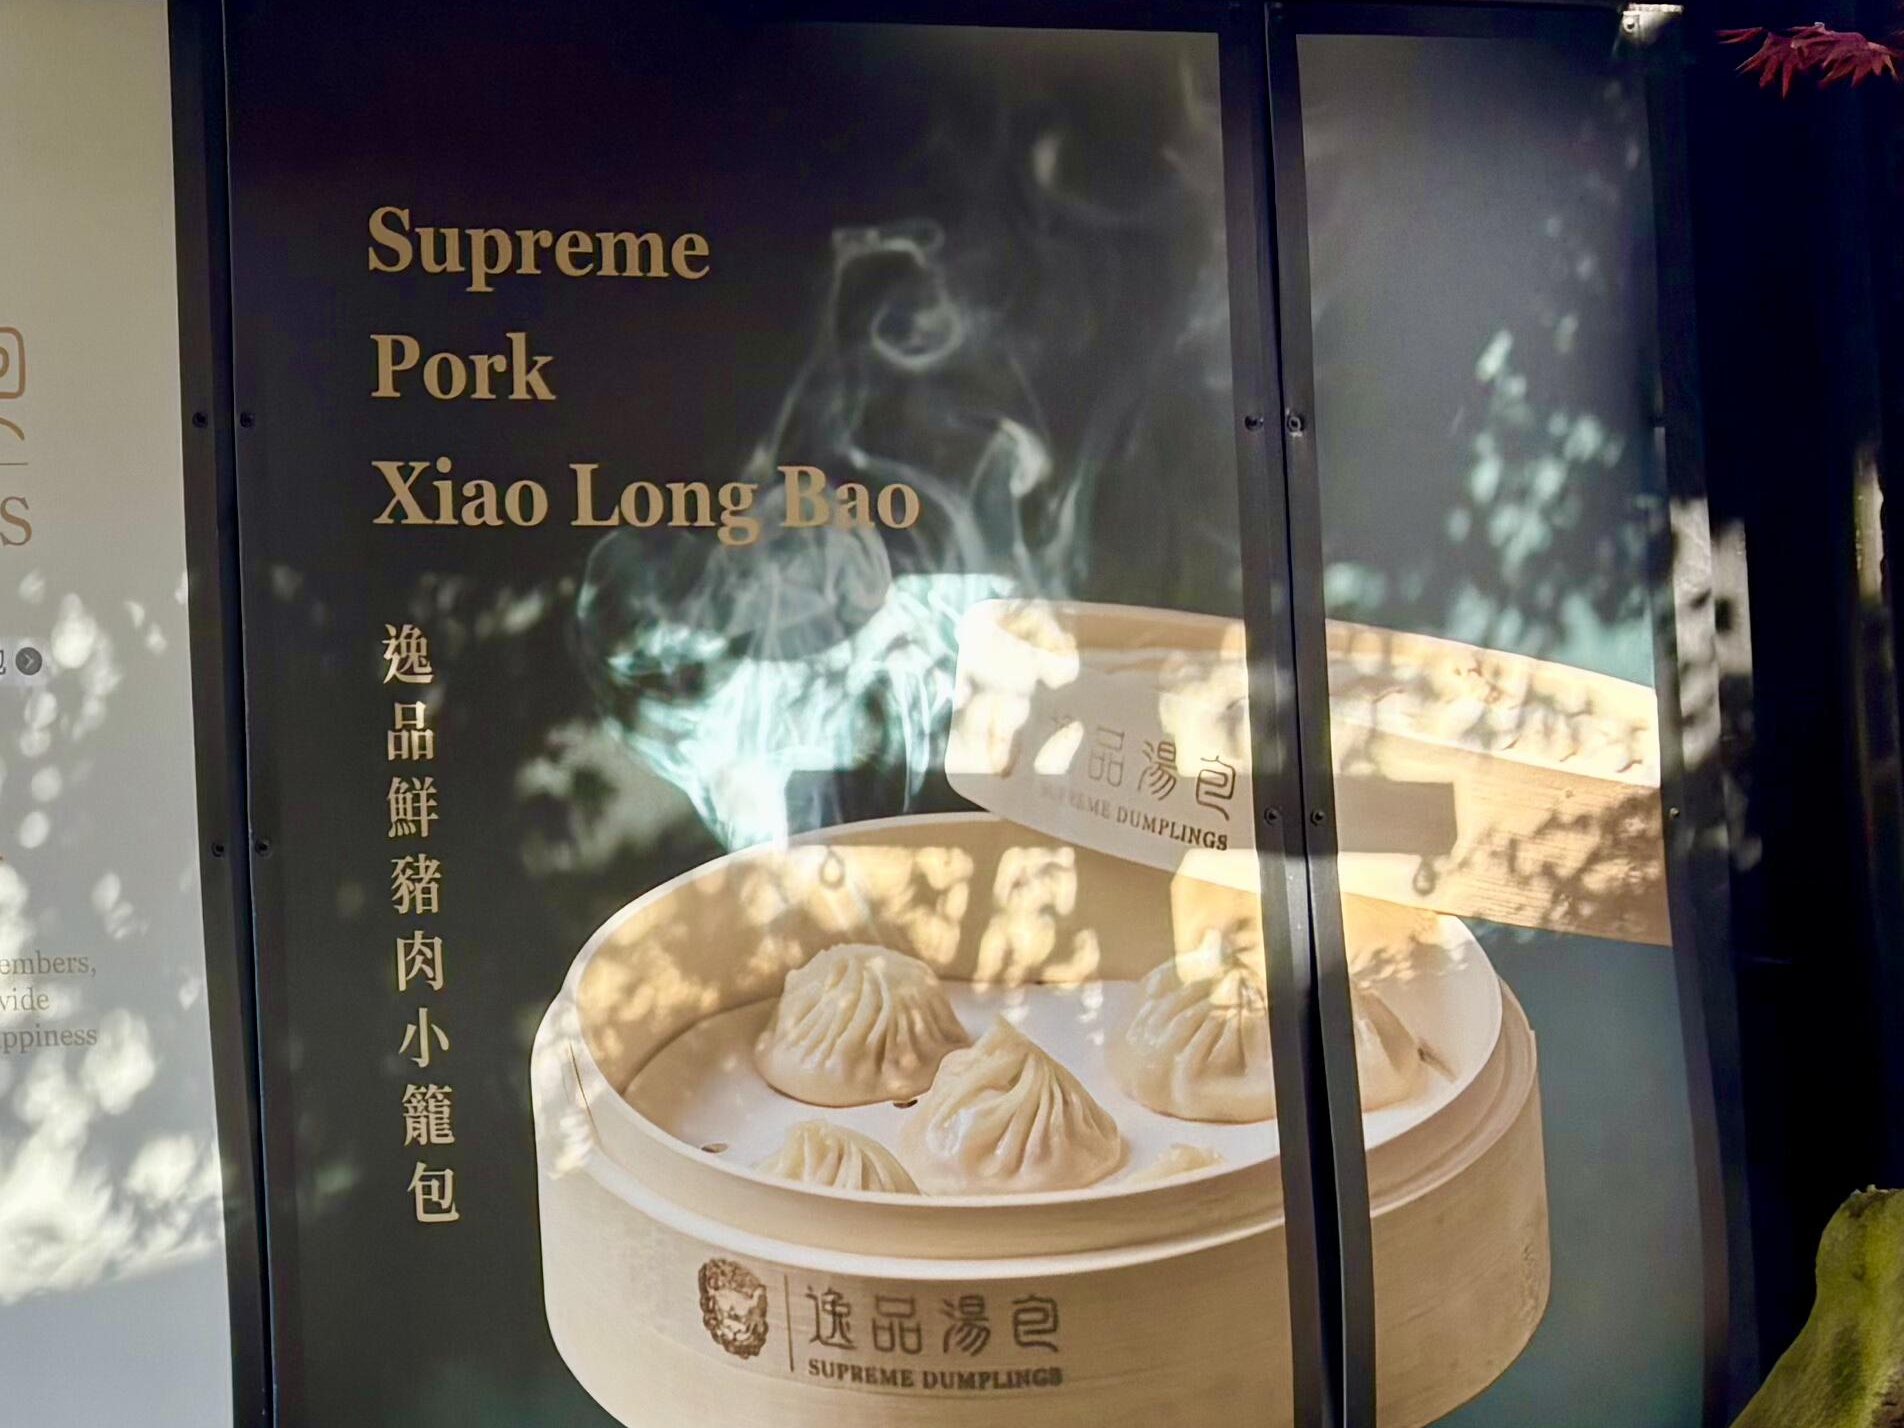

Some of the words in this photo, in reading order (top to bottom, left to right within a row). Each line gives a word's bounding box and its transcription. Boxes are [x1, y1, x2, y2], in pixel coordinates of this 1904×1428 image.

[367, 206, 711, 293] Supreme
[371, 332, 555, 405] Pork
[373, 459, 548, 530] Xiao
[570, 462, 761, 547] Long
[777, 464, 920, 530] Bao
[1047, 715, 1237, 822] 品湯包
[1116, 805, 1228, 851] DUMPLINGS
[382, 623, 459, 1223] 逸品鮮豬肉小籠包
[805, 1286, 1059, 1357] 逸品湯包
[808, 1359, 914, 1389] SUPREME
[923, 1367, 1063, 1391] DUMPLINGS
